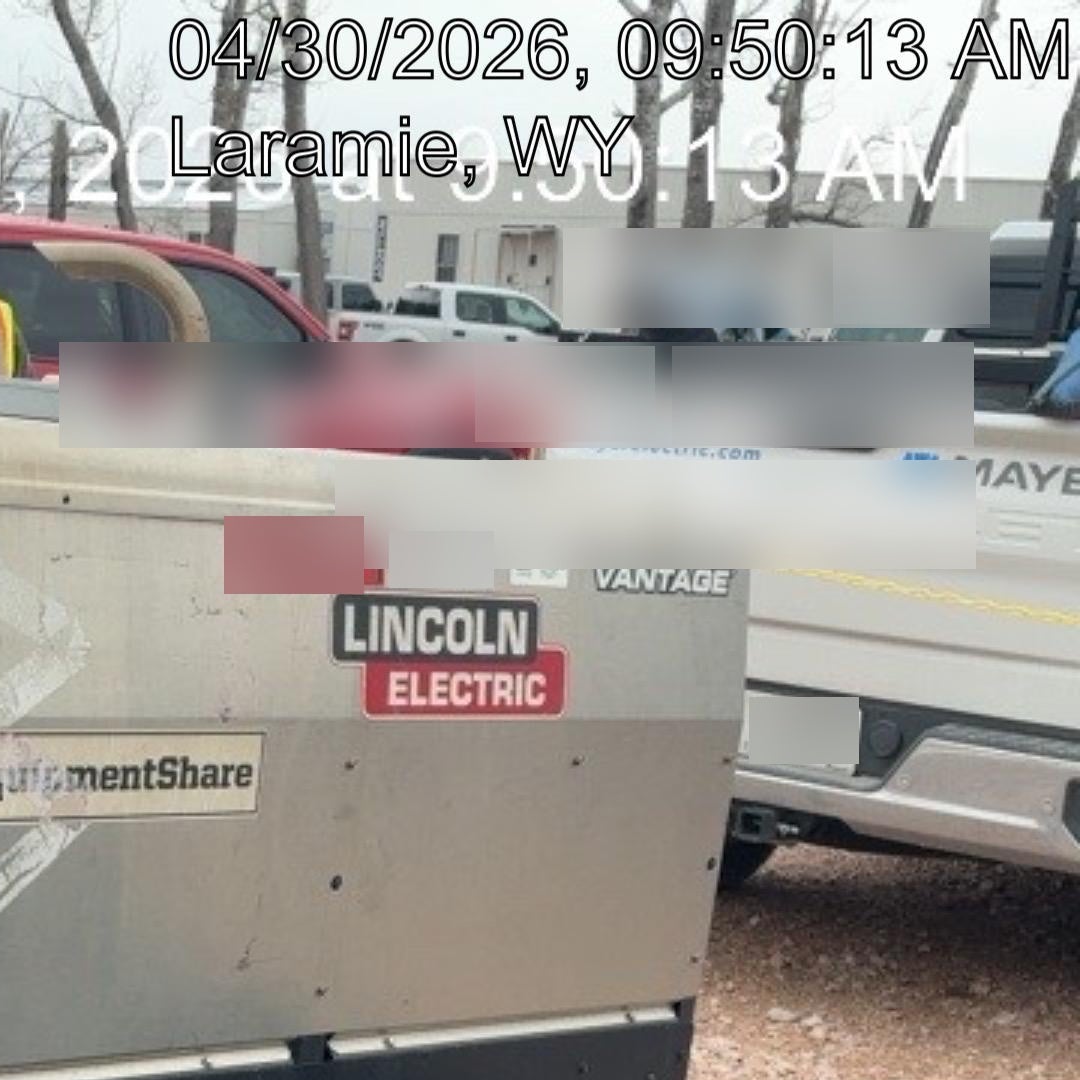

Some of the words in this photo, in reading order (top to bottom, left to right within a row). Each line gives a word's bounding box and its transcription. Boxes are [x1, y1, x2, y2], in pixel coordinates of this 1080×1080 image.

[595, 569, 732, 595] VANTAGE
[343, 603, 528, 656] LINCOLN
[387, 671, 547, 707] ELECTRIC
